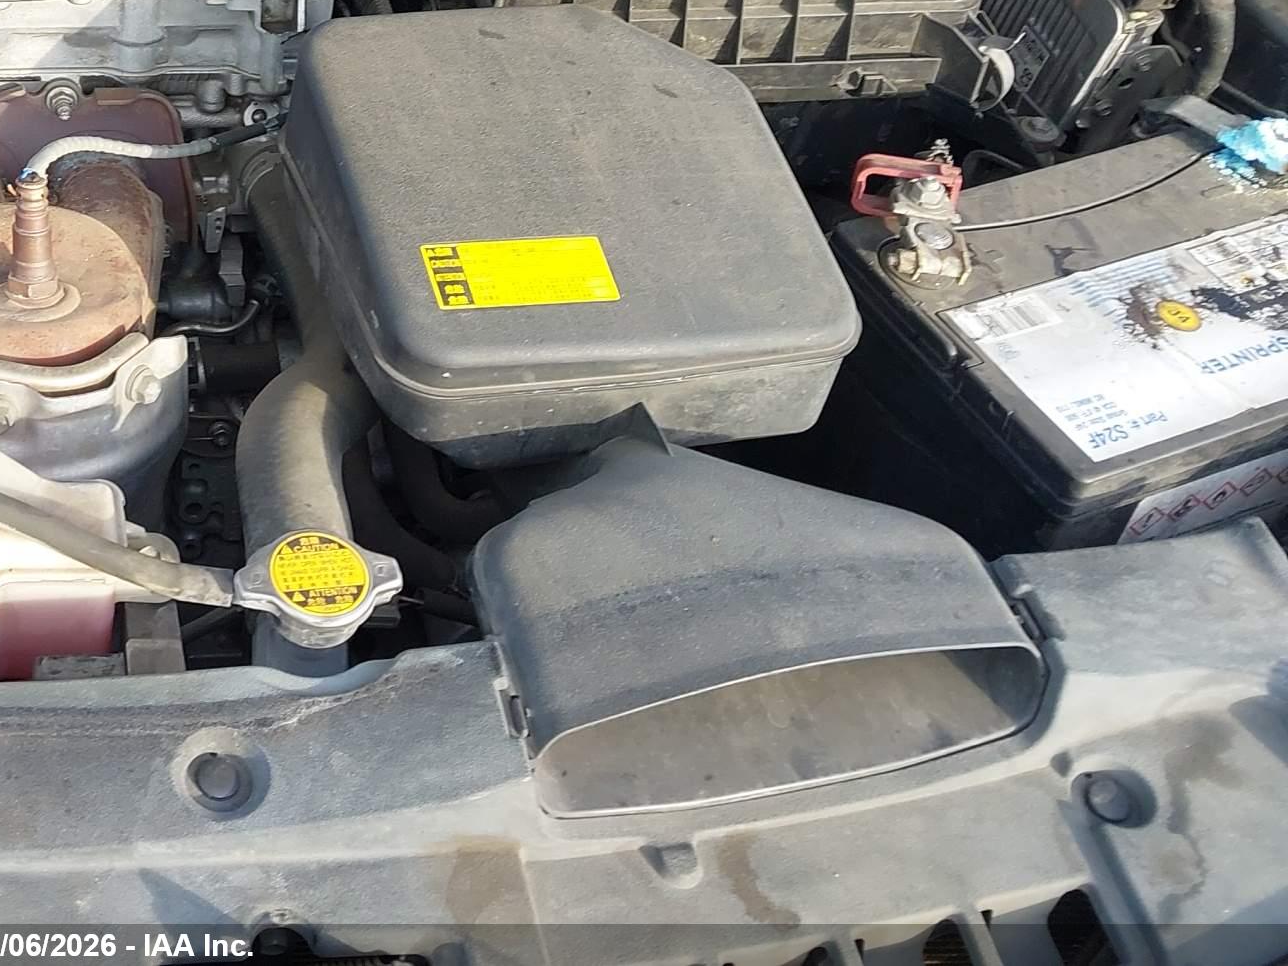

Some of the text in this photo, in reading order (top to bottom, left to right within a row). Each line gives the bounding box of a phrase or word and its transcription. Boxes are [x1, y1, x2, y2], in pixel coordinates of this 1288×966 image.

[1138, 411, 1169, 426] Part
[1088, 424, 1129, 449] S24F
[293, 543, 340, 553] CAUTION
[309, 586, 358, 597] ATTENTION
